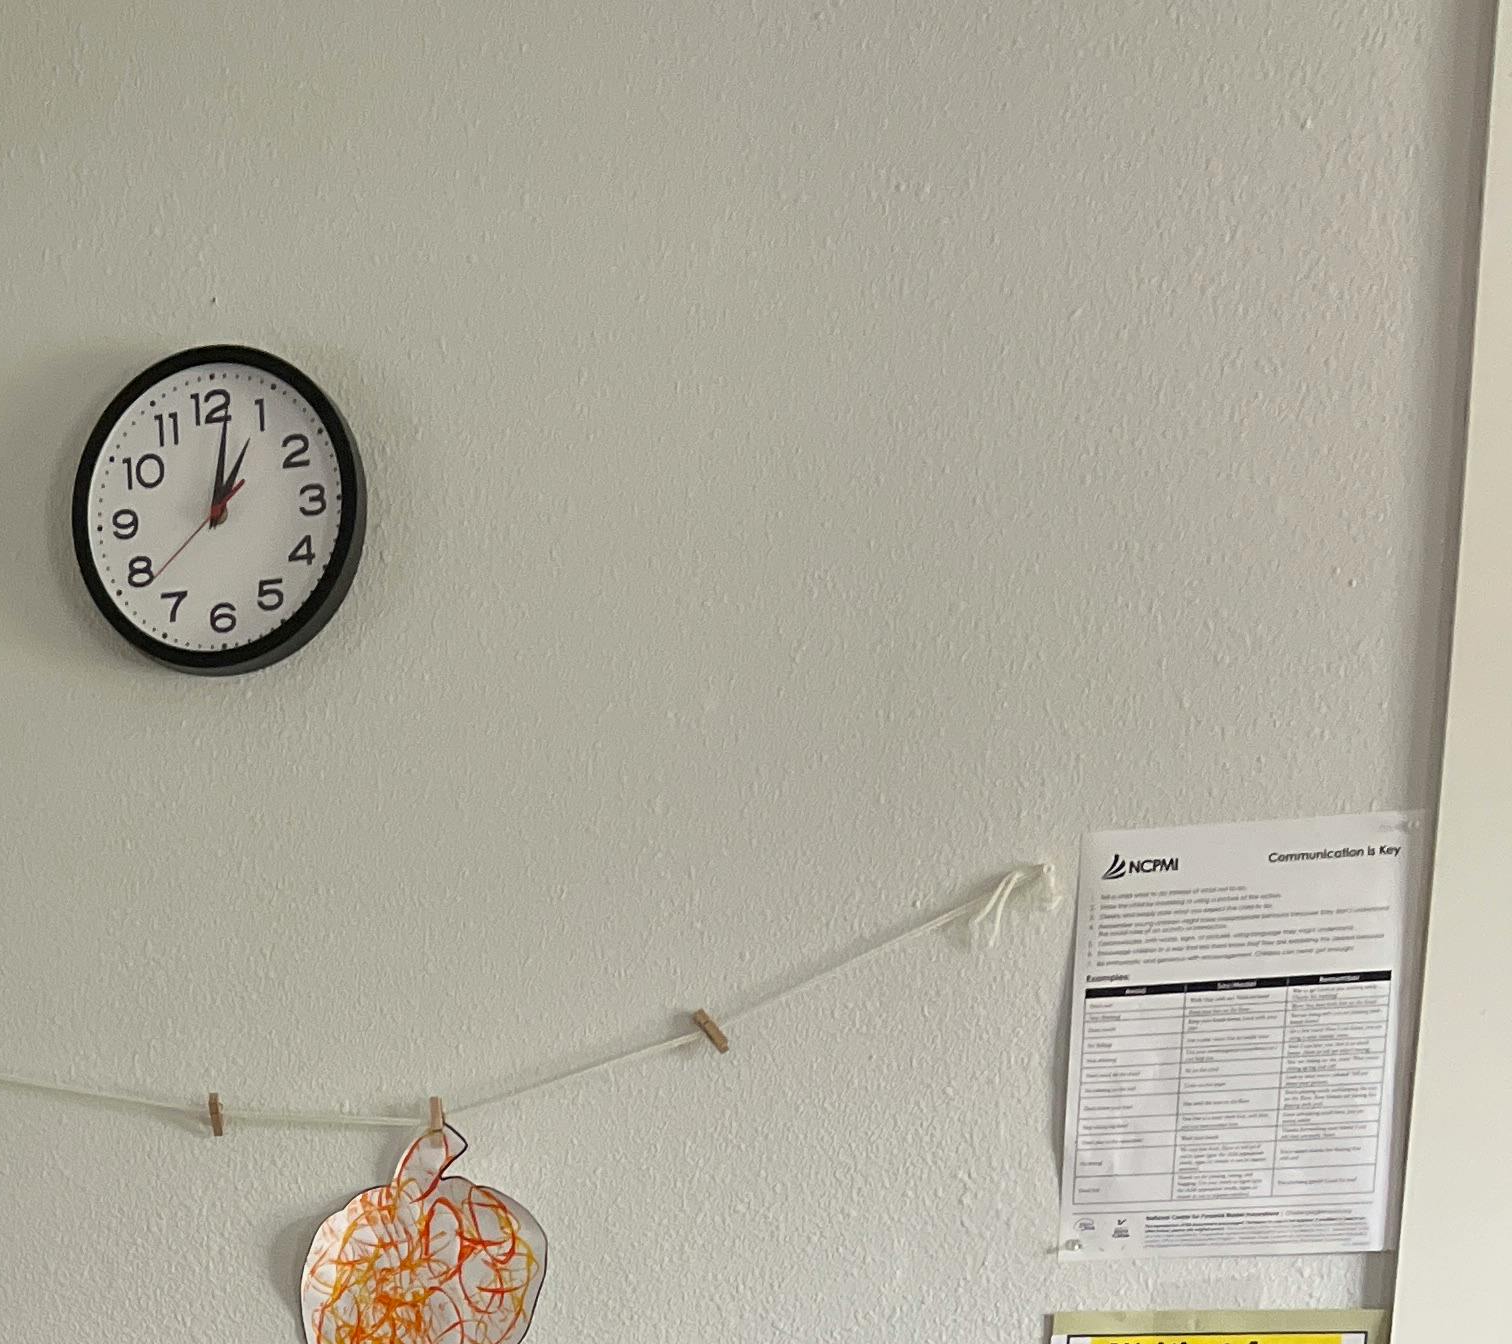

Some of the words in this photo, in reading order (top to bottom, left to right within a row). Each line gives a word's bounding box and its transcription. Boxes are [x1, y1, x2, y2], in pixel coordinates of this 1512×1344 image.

[190, 388, 232, 427] 12
[254, 398, 266, 432] 1
[154, 411, 179, 448] 11
[281, 433, 311, 469] 2
[122, 453, 165, 490] 10
[299, 483, 327, 516] 3
[112, 508, 139, 540] 9
[287, 534, 317, 566] 4
[127, 555, 154, 588] 8
[160, 590, 188, 623] 7
[256, 577, 285, 611] 5
[209, 602, 237, 633] 6
[1129, 858, 1179, 874] NCPMI
[1268, 847, 1365, 863] Communication
[1379, 844, 1401, 857] Key
